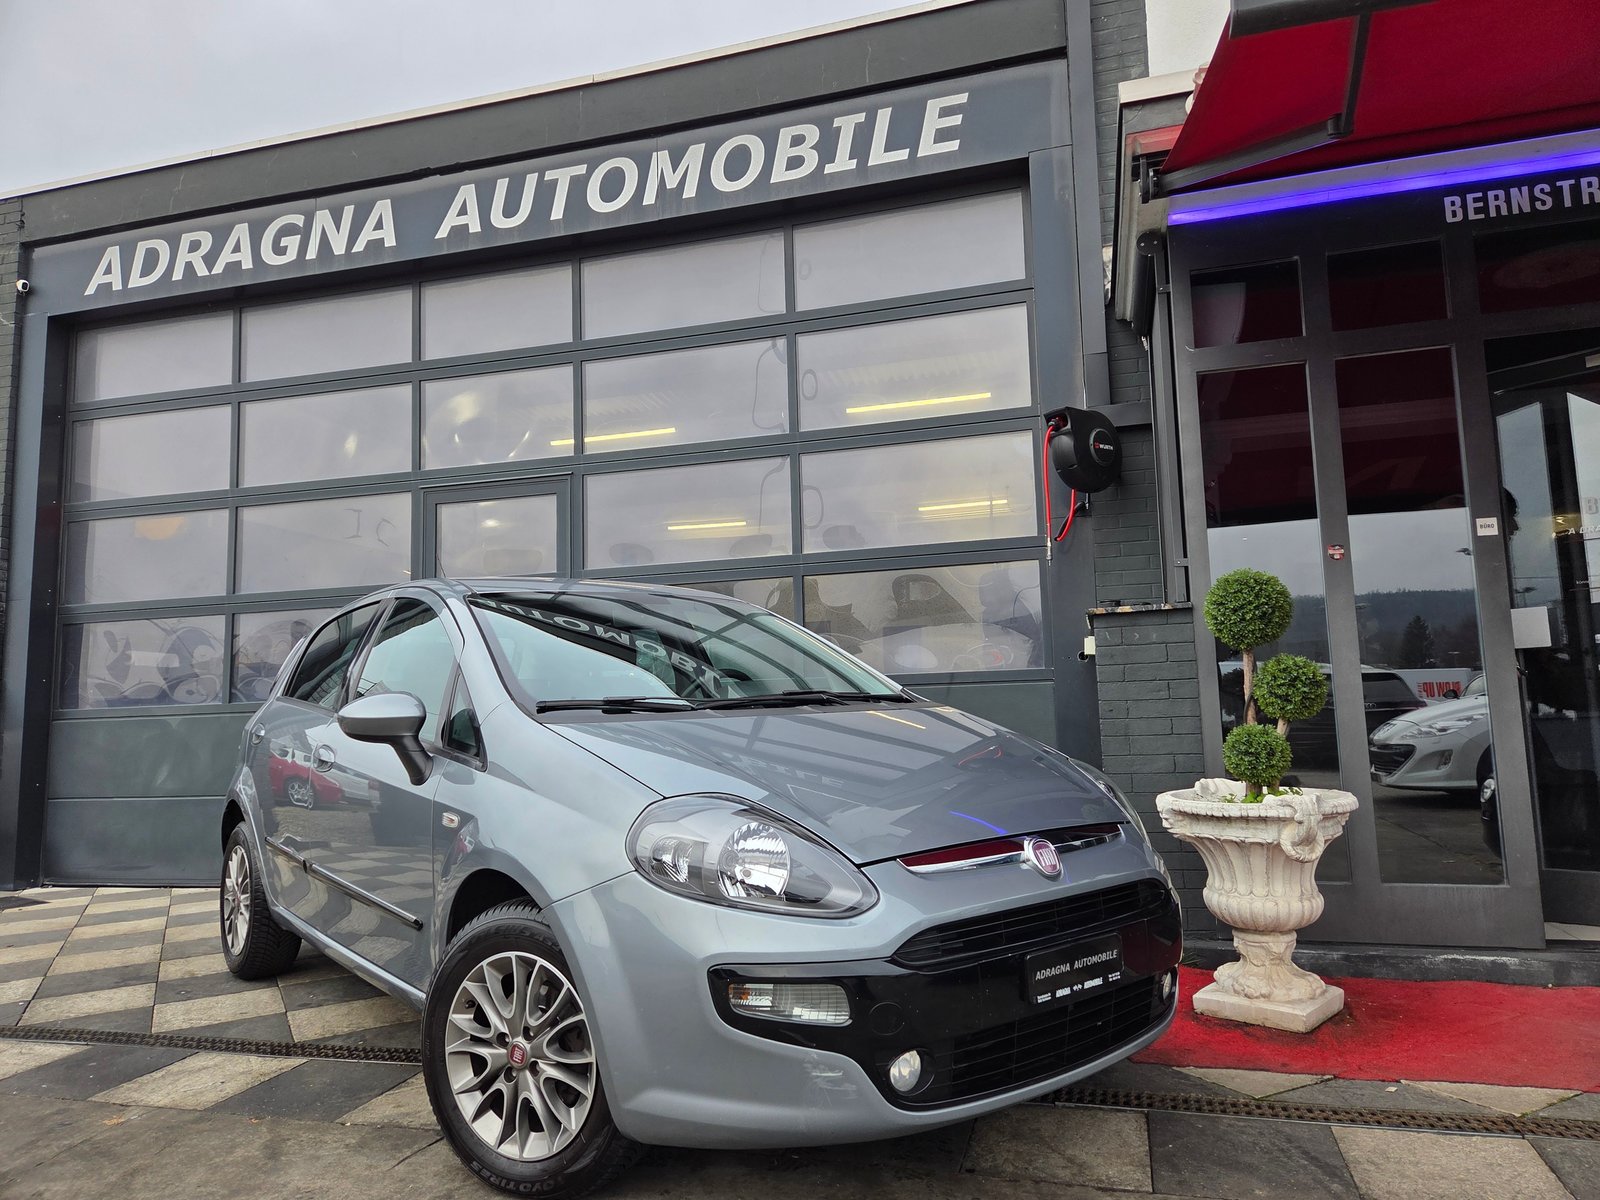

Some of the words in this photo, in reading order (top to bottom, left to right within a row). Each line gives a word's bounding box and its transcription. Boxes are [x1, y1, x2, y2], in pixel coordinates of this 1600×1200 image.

[84, 198, 397, 296] ADRAGNA
[434, 93, 969, 239] AUTOMOBILE
[1443, 176, 1600, 224] BERNSTR
[1035, 847, 1058, 867] FIAT
[1035, 962, 1071, 981] ADRAGNA
[1073, 949, 1118, 970] AUTOMOBILE
